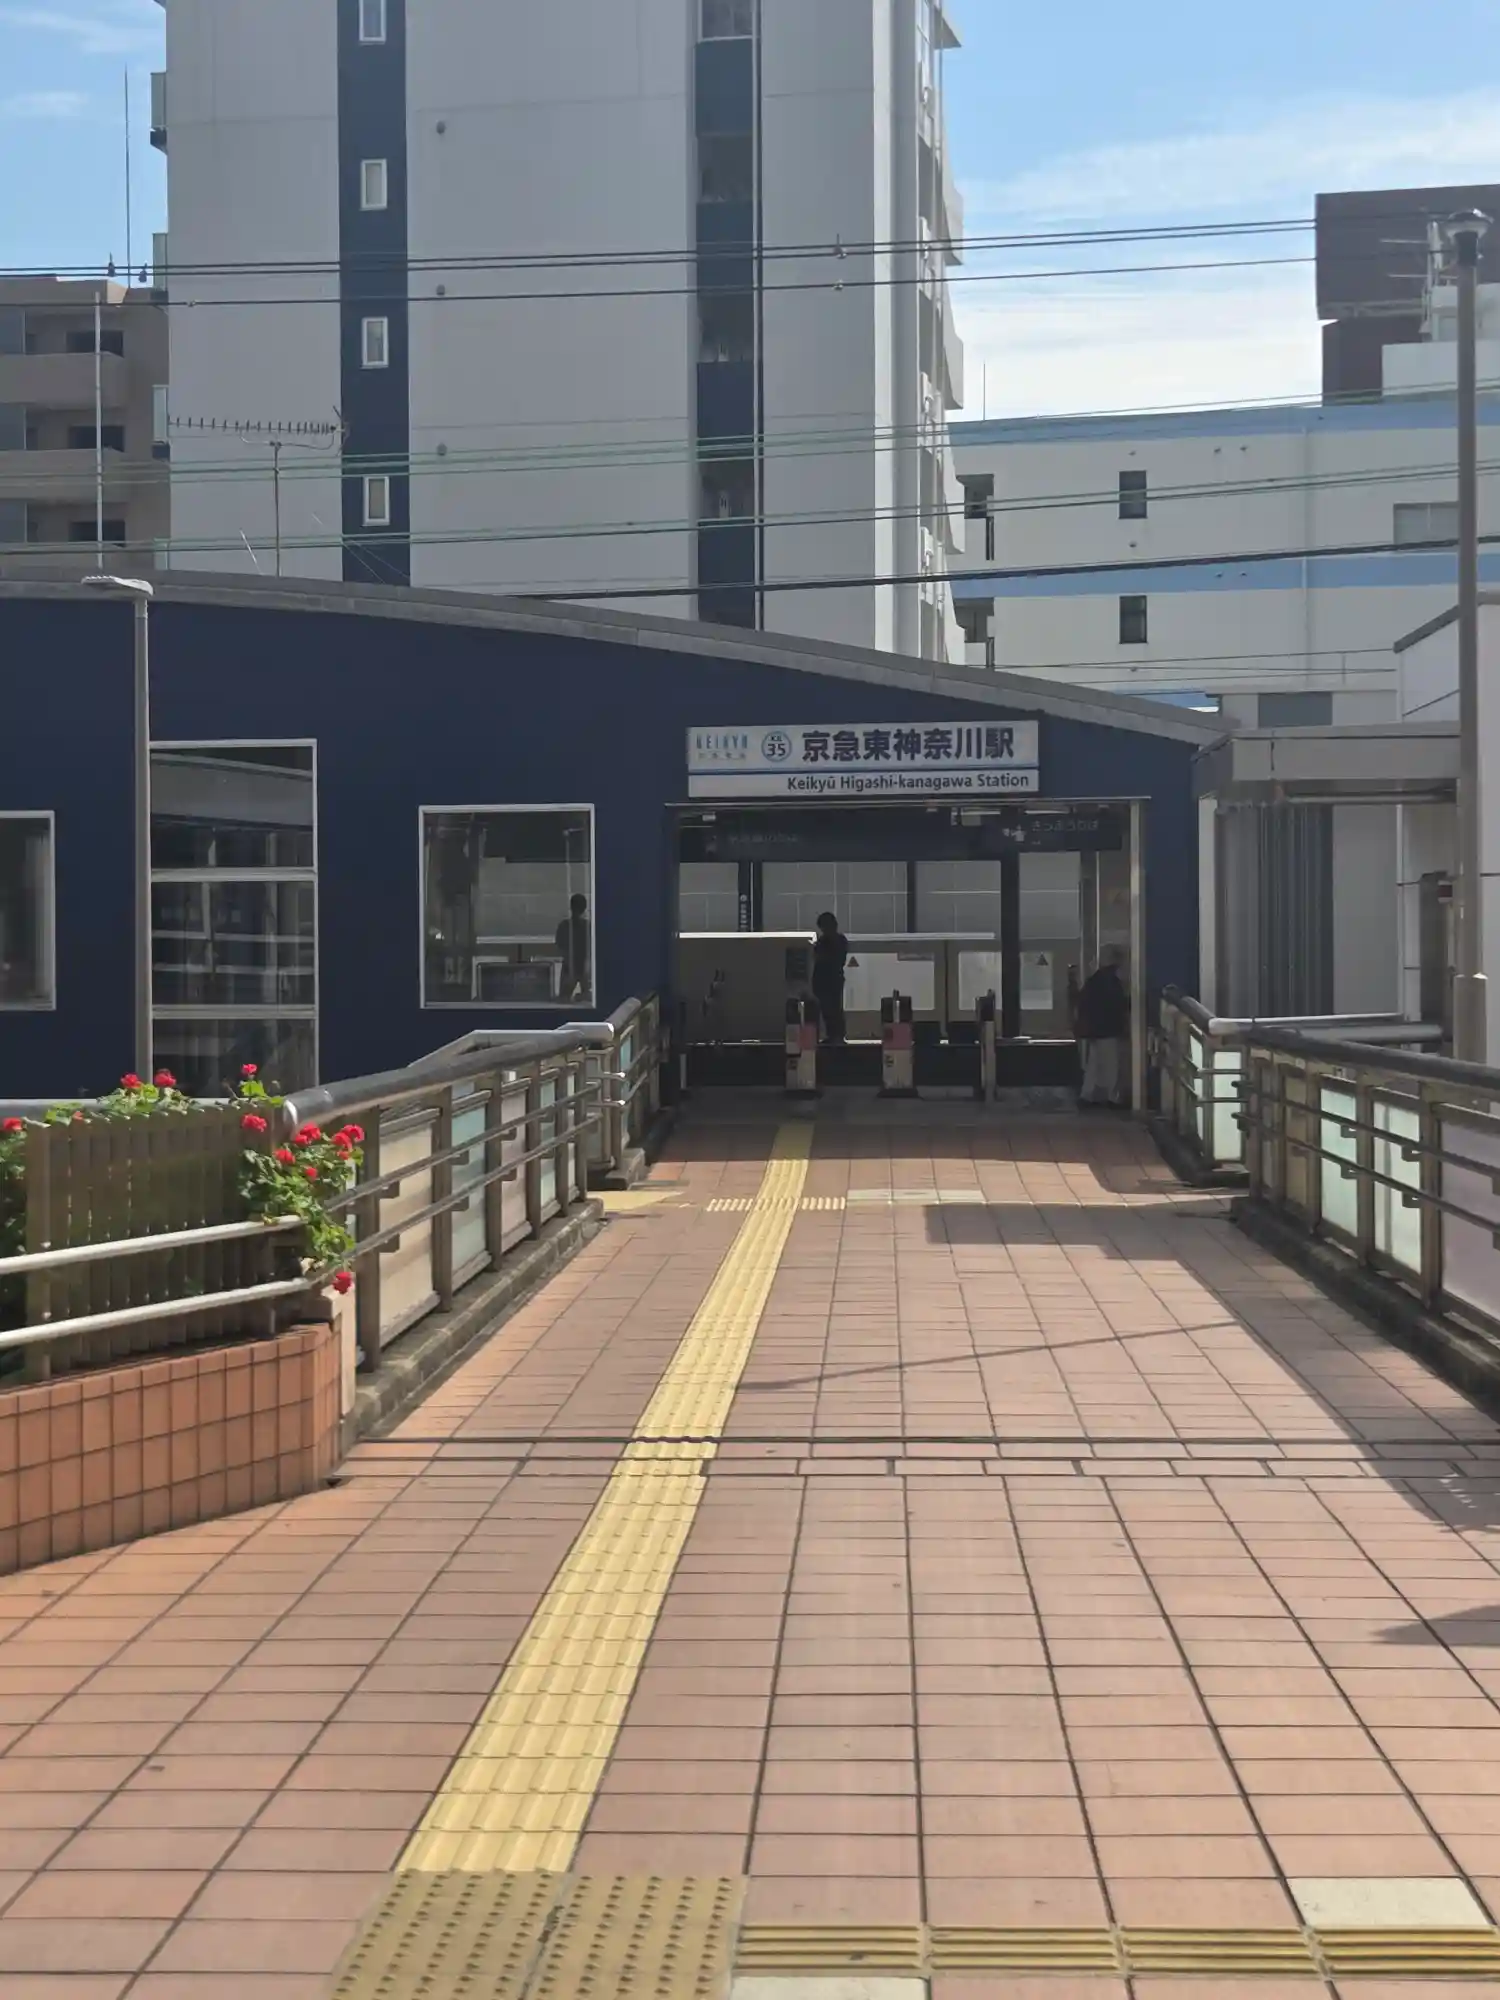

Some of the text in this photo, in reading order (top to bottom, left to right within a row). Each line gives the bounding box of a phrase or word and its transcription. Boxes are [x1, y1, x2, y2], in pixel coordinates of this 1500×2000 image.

[767, 743, 786, 757] 35
[802, 727, 1014, 762] 京急東神奈川駅
[788, 772, 1029, 792] Keikyū Higashi-kanagawa Station
